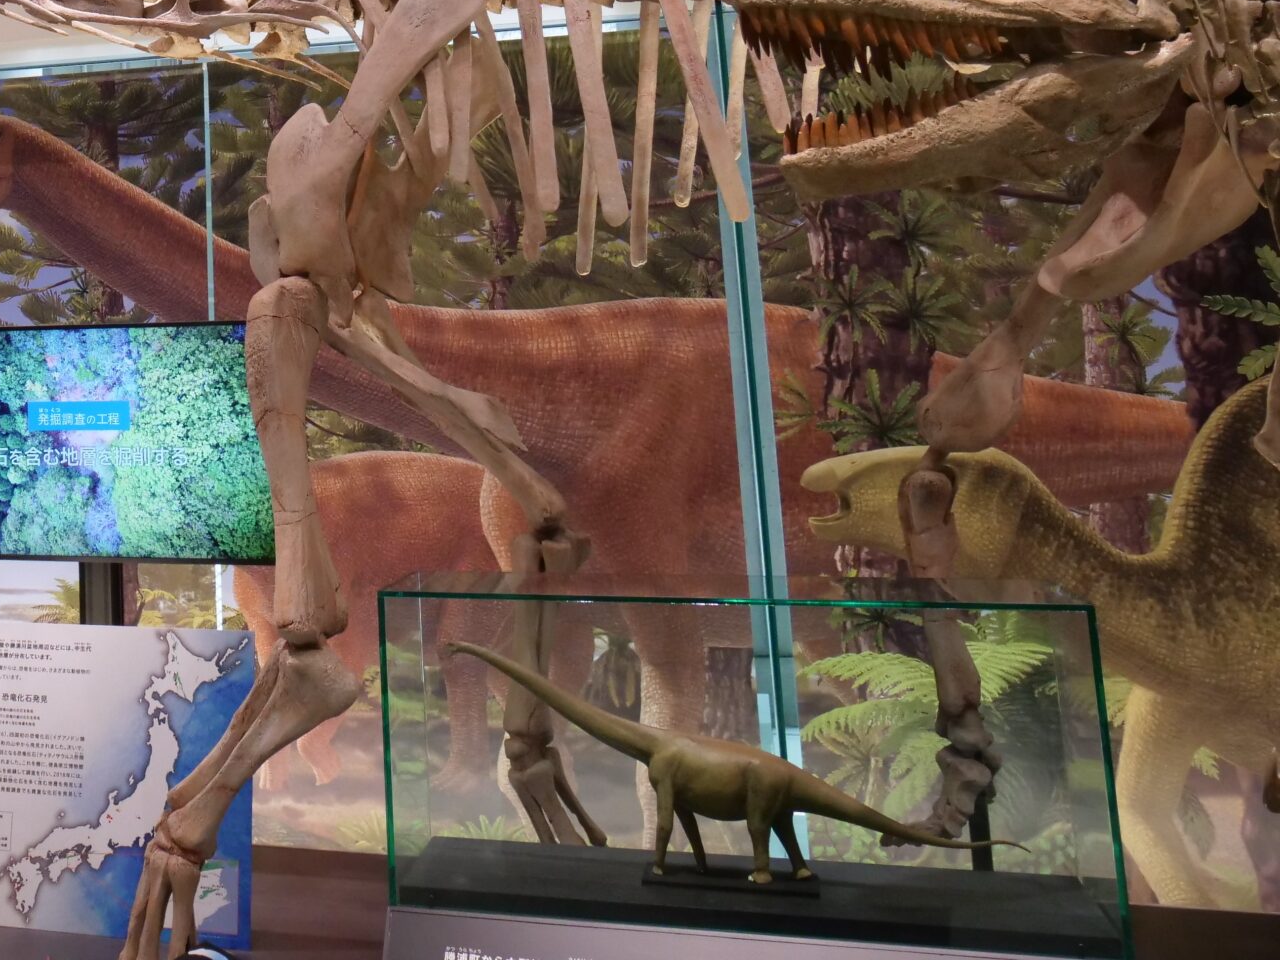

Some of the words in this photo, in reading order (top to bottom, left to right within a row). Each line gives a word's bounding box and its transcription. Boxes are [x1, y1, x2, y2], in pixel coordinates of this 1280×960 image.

[38, 412, 120, 426] 発掘調査の工程
